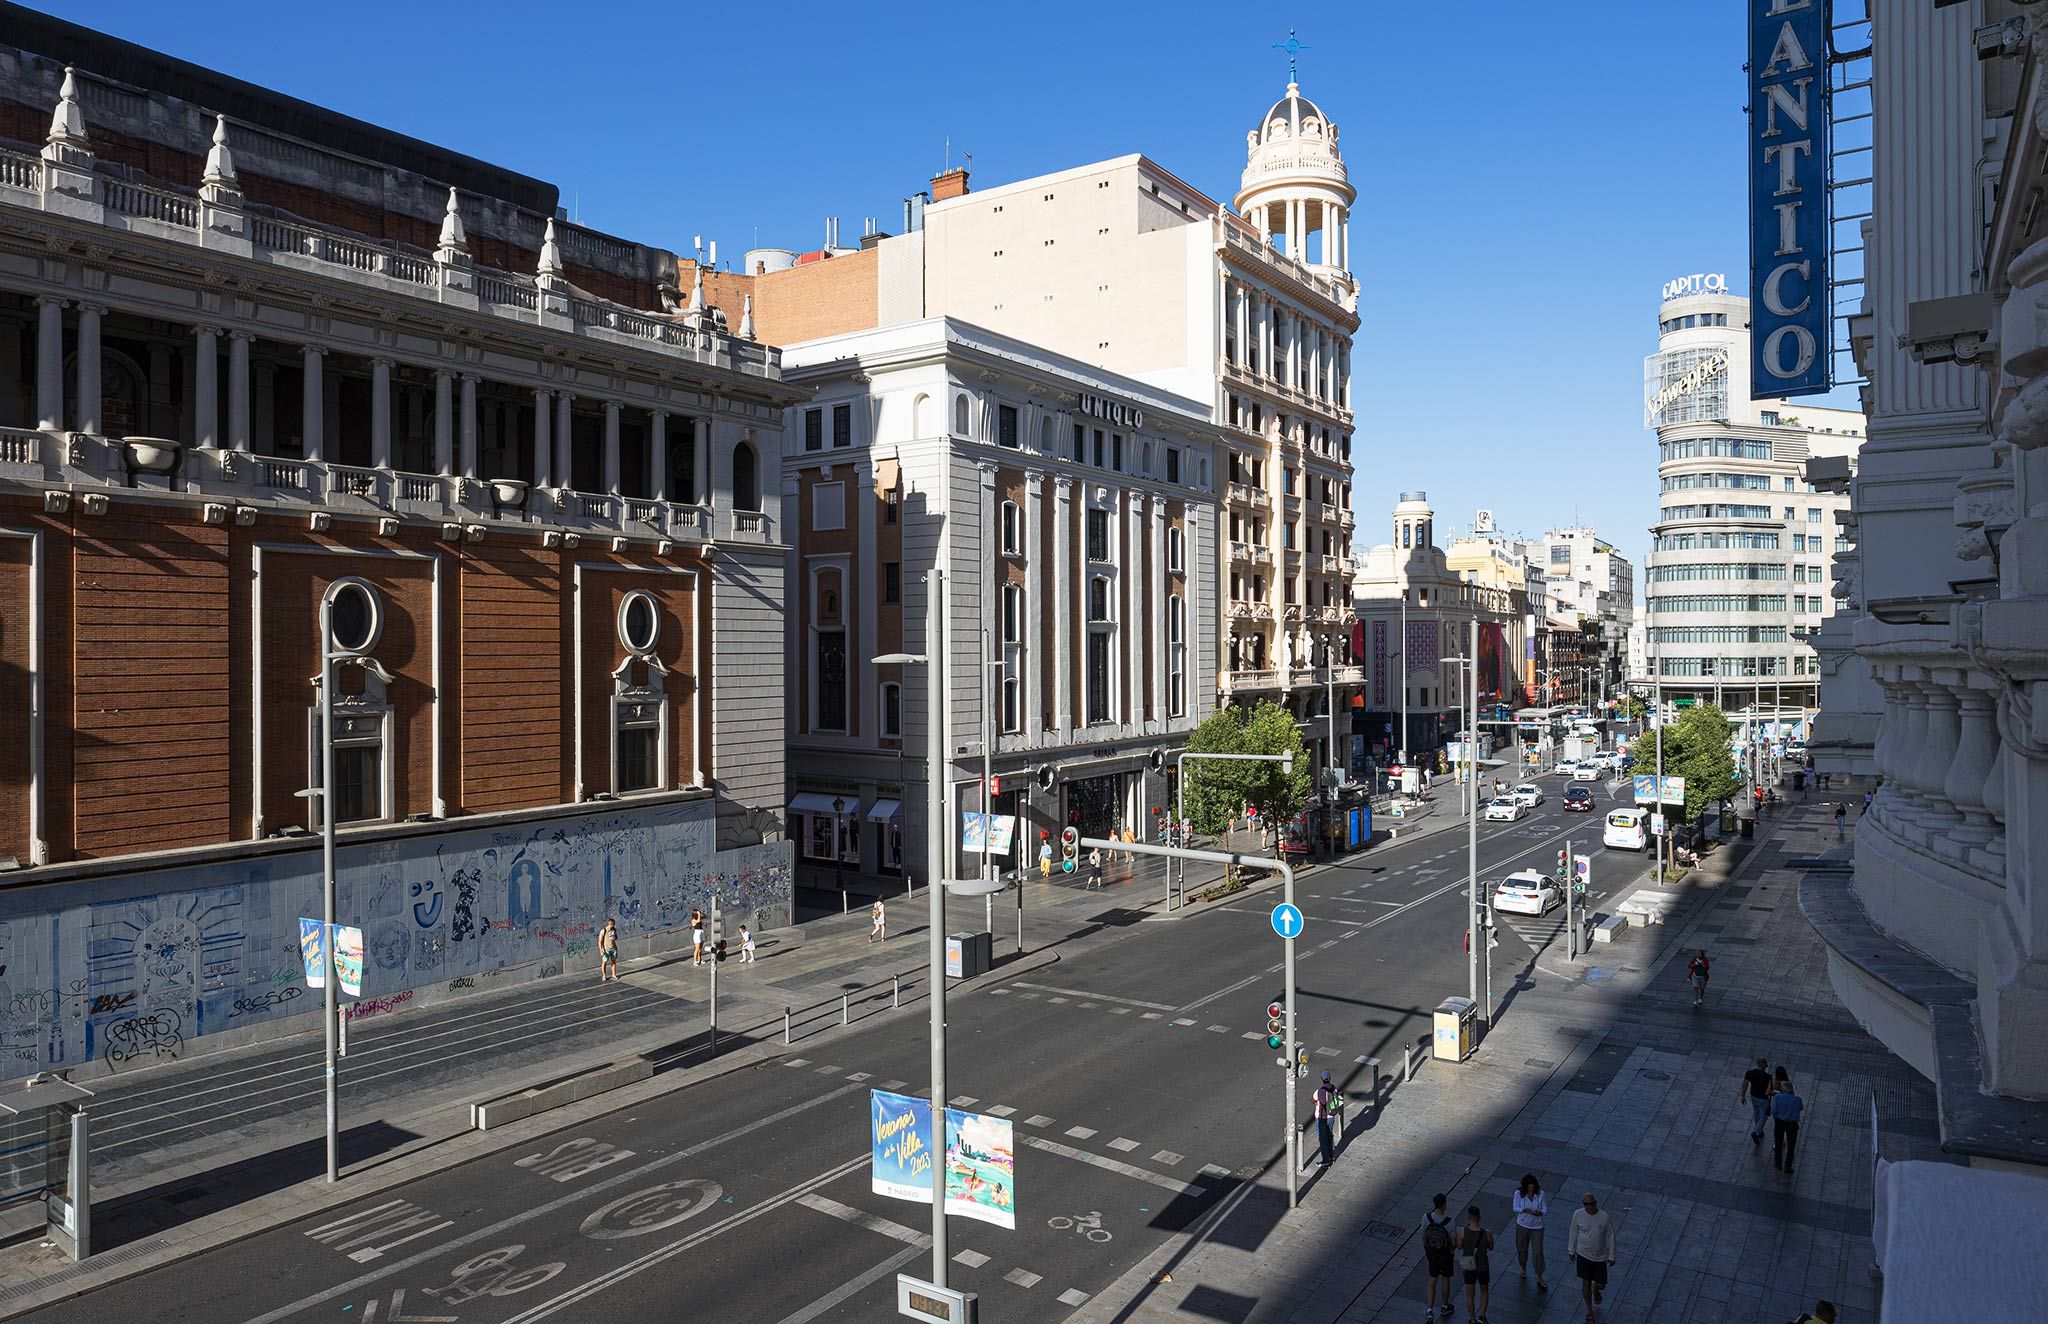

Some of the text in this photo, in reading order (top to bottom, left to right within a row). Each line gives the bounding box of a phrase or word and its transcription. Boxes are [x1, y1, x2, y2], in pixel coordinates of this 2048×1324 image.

[1761, 0, 1816, 379] ANTICO
[1663, 273, 1729, 300] CAPITOL
[1647, 347, 1729, 418] Schweppes
[1080, 393, 1143, 428] UNIQLO
[874, 1106, 916, 1145] Veranos
[896, 1130, 924, 1170] Villa
[910, 1152, 931, 1178] 2023
